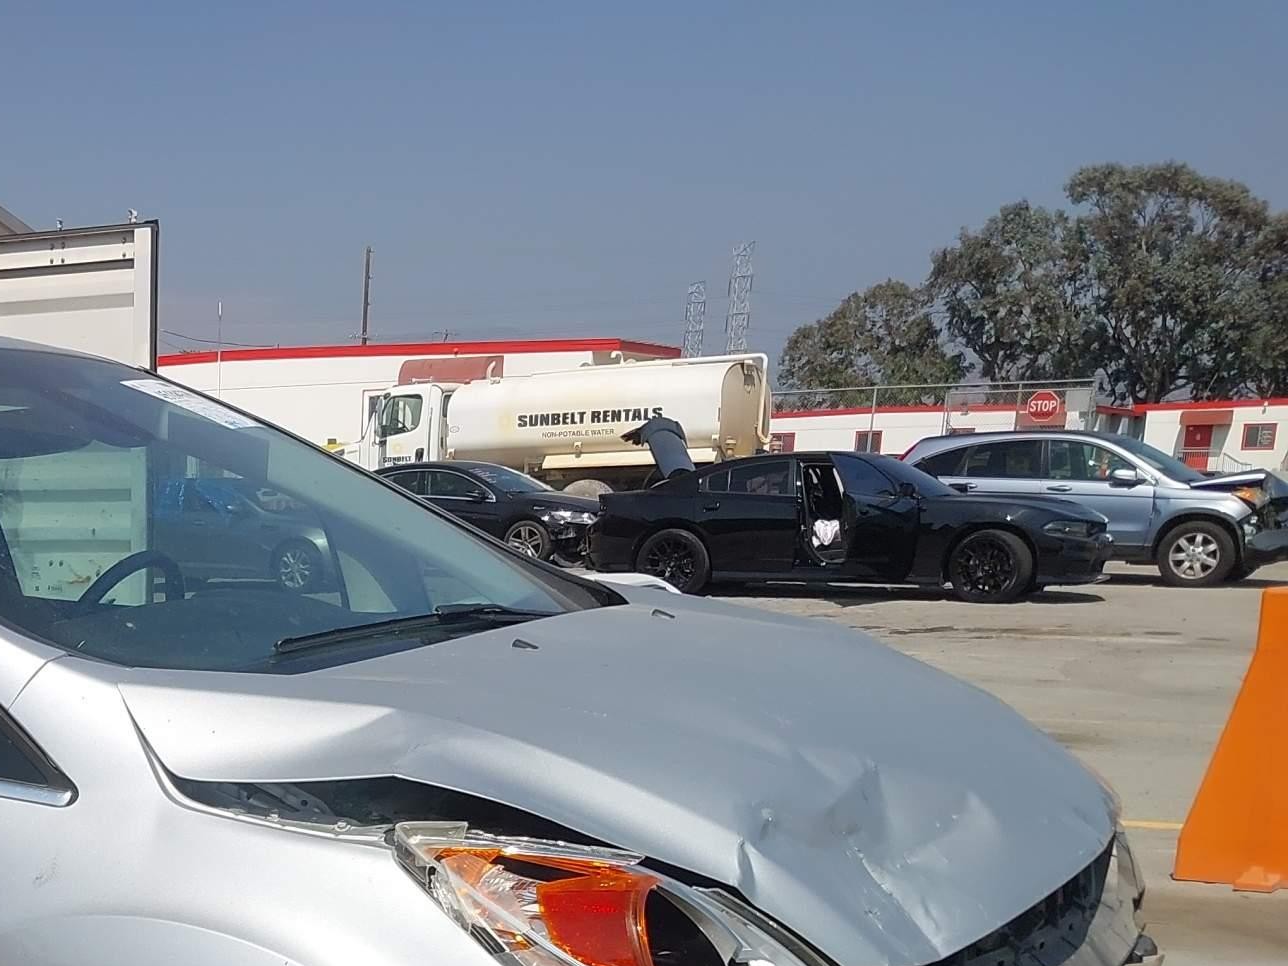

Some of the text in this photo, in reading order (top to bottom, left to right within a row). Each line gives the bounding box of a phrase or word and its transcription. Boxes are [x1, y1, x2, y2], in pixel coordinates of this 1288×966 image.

[1029, 400, 1057, 412] STOP
[517, 407, 663, 428] SUNBELT RENTALS
[541, 428, 614, 439] NON-POTABLE WATER
